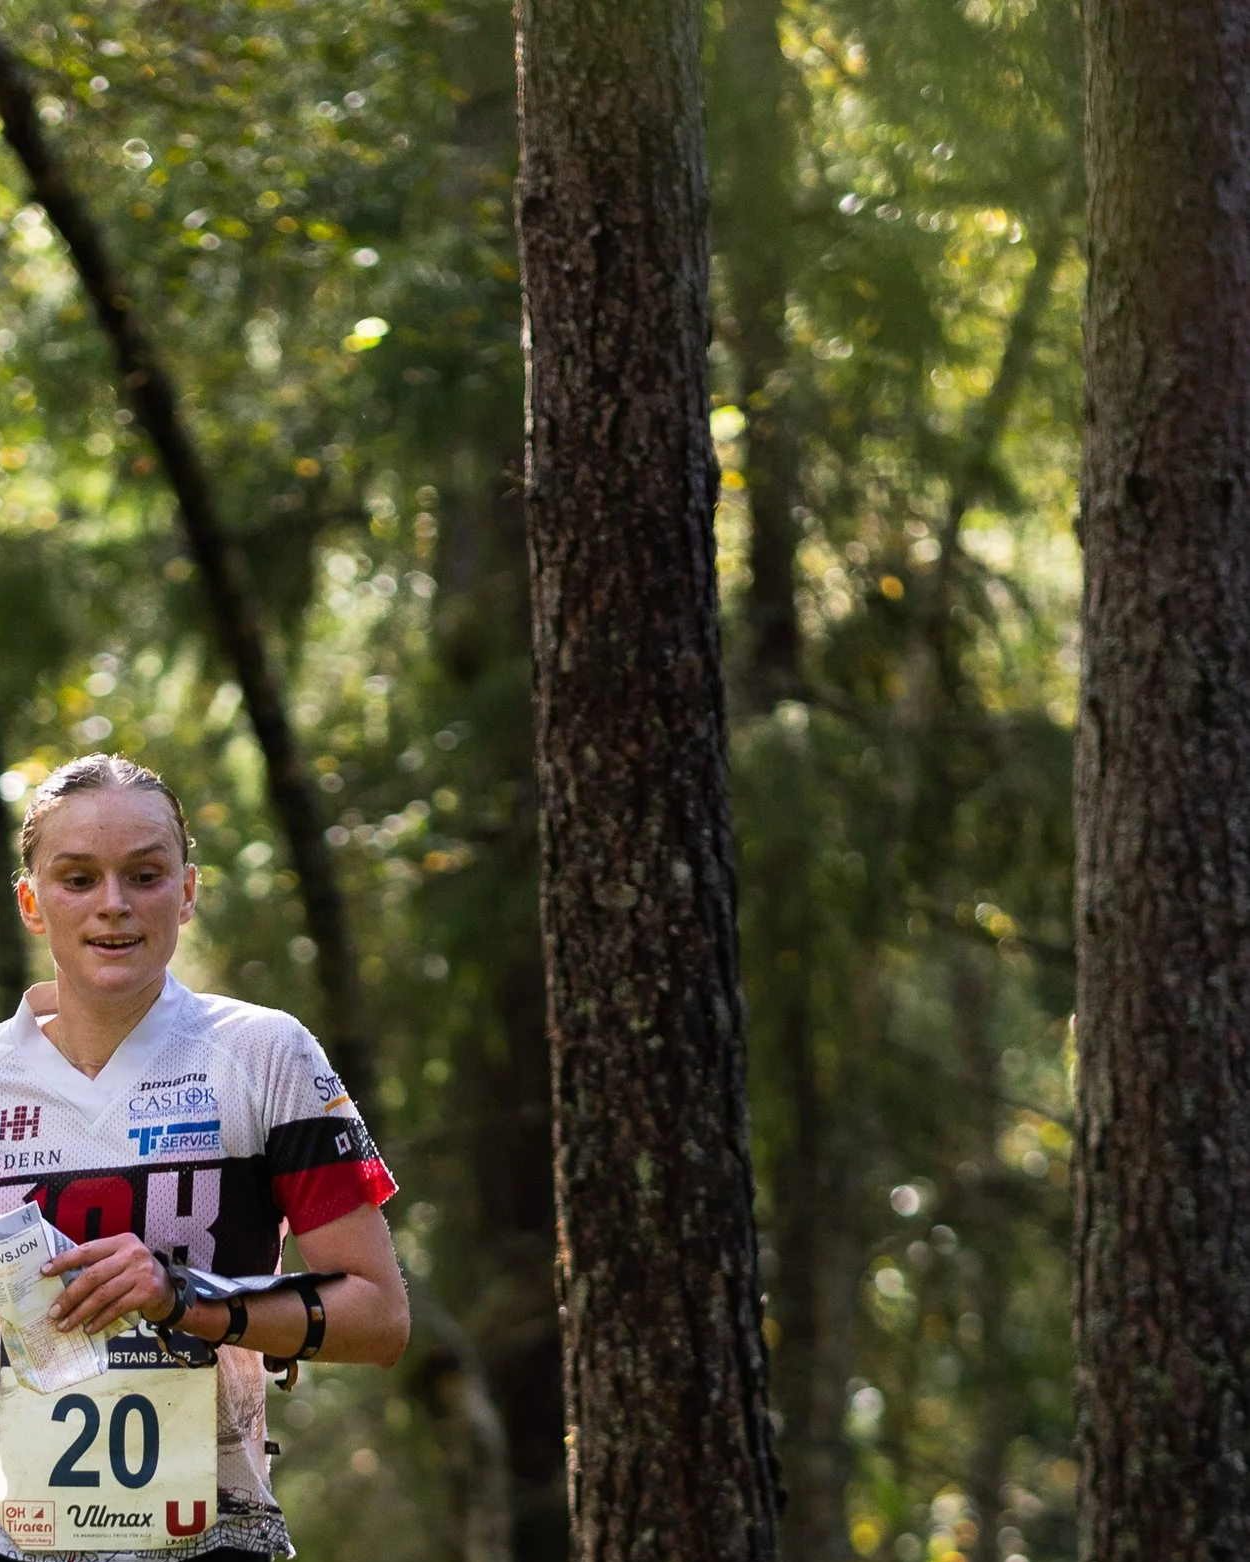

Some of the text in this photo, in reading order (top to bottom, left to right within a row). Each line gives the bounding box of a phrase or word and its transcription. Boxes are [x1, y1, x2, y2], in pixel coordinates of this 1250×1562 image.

[140, 1073, 208, 1091] noname
[314, 1073, 346, 1101] Str
[128, 1087, 218, 1112] CASTOR
[161, 1133, 220, 1148] SERVICE
[109, 1351, 158, 1363] ISTANS
[48, 1393, 159, 1489] 20
[6, 1520, 53, 1533] Tisaren
[66, 1504, 154, 1528] Ullmax
